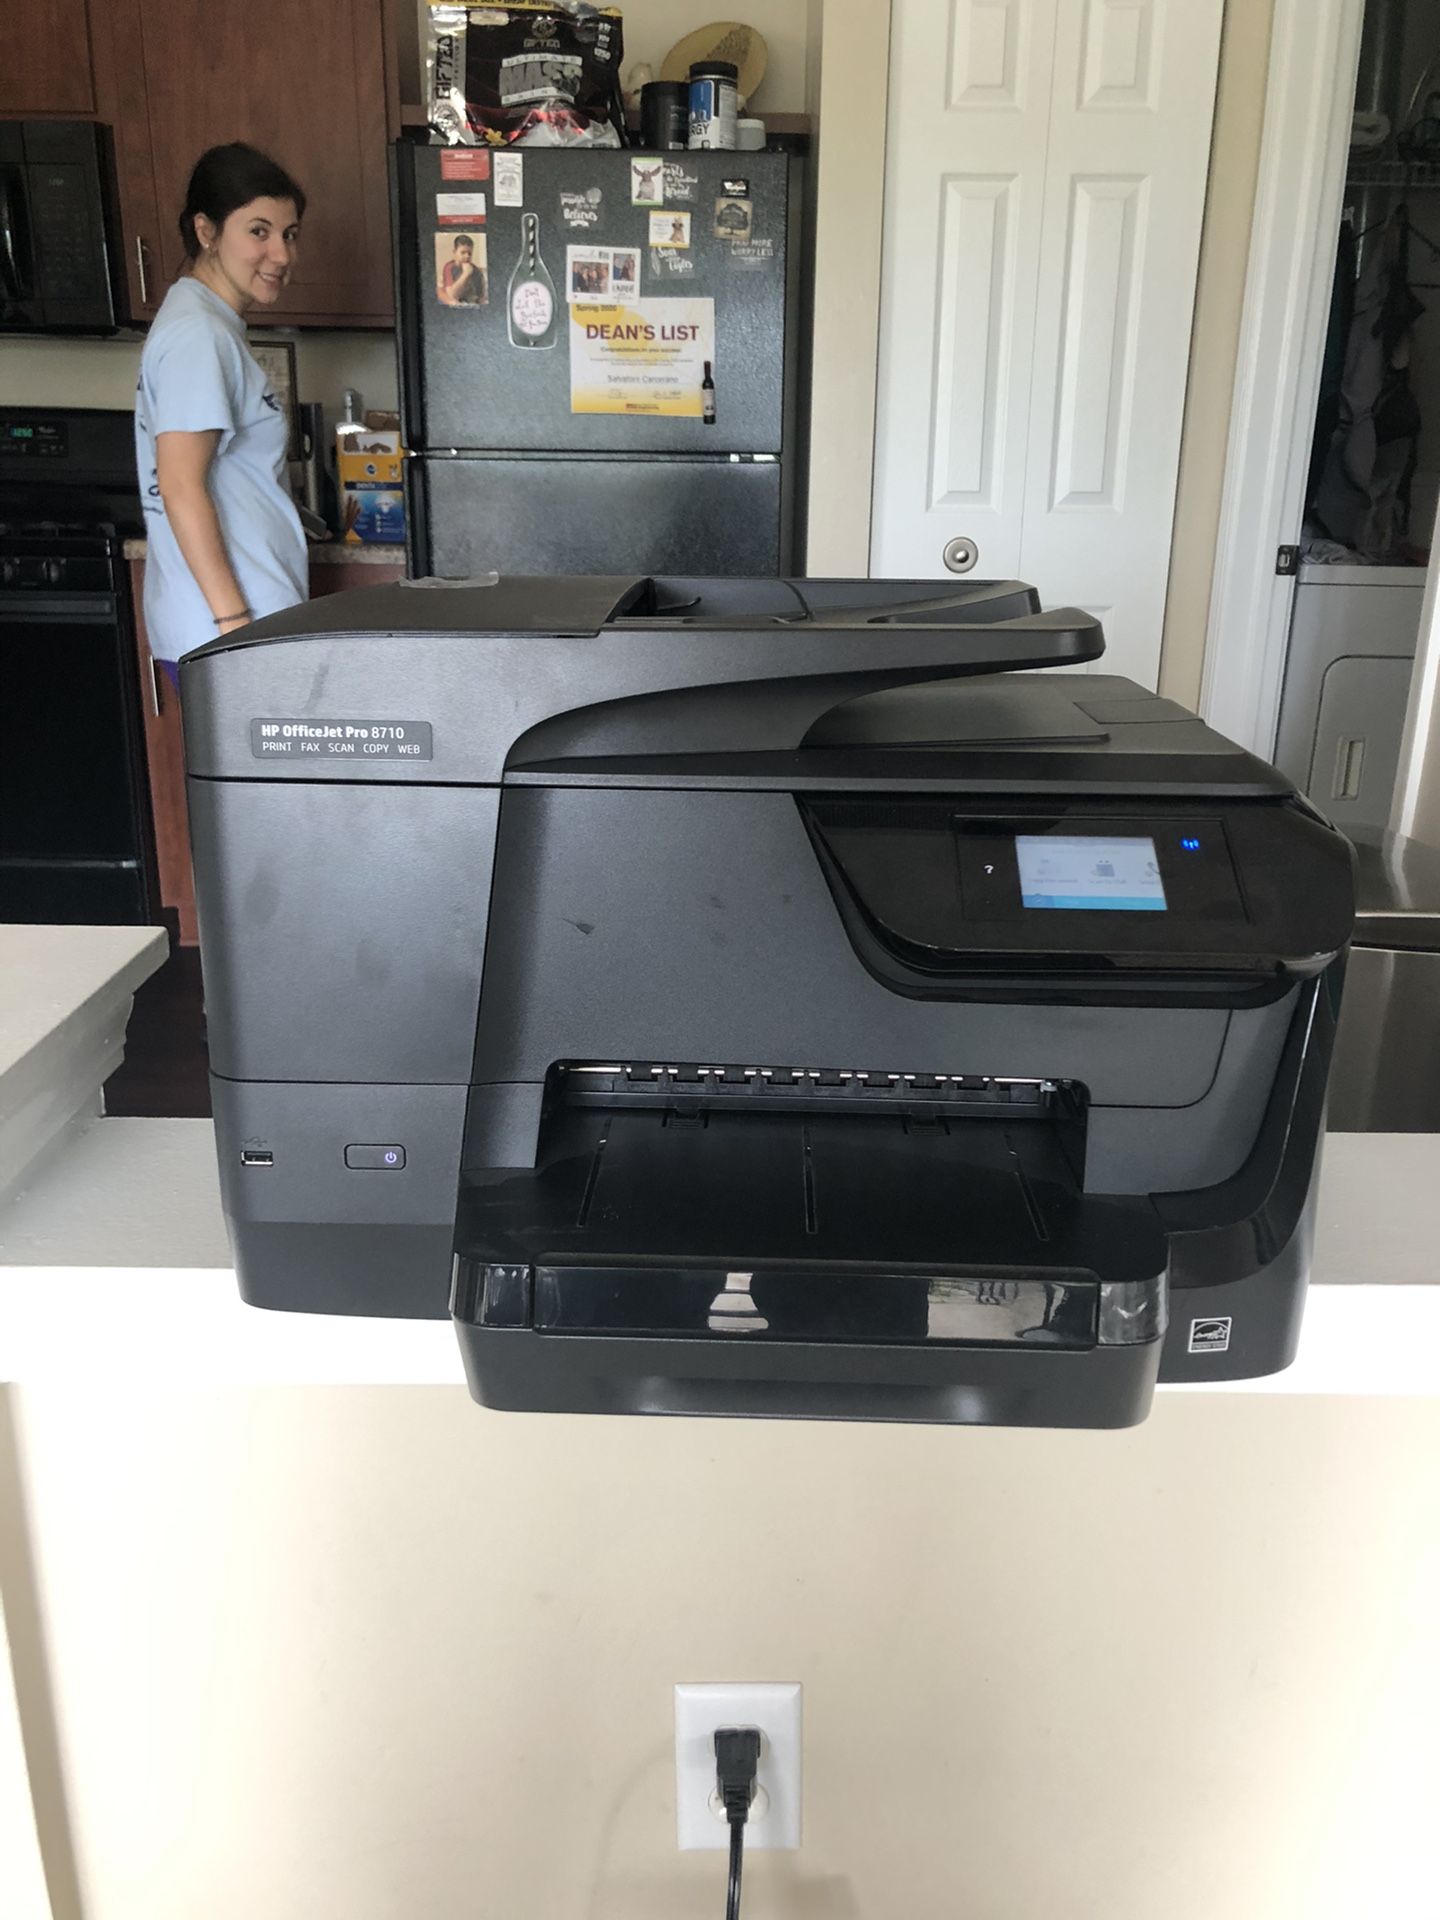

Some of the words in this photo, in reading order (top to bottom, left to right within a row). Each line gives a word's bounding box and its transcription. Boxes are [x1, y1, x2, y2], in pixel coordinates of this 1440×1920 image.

[586, 324, 656, 340] DEAN'S
[661, 325, 700, 341] LIST
[261, 725, 279, 737] HP
[283, 725, 343, 738] OfficeJet
[346, 726, 368, 739] Pro
[371, 727, 404, 740] 8710
[262, 742, 292, 752] PRINT
[300, 742, 320, 752] FAX
[328, 743, 355, 753] SCAN
[363, 743, 389, 754] COPY
[398, 744, 420, 754] WEB
